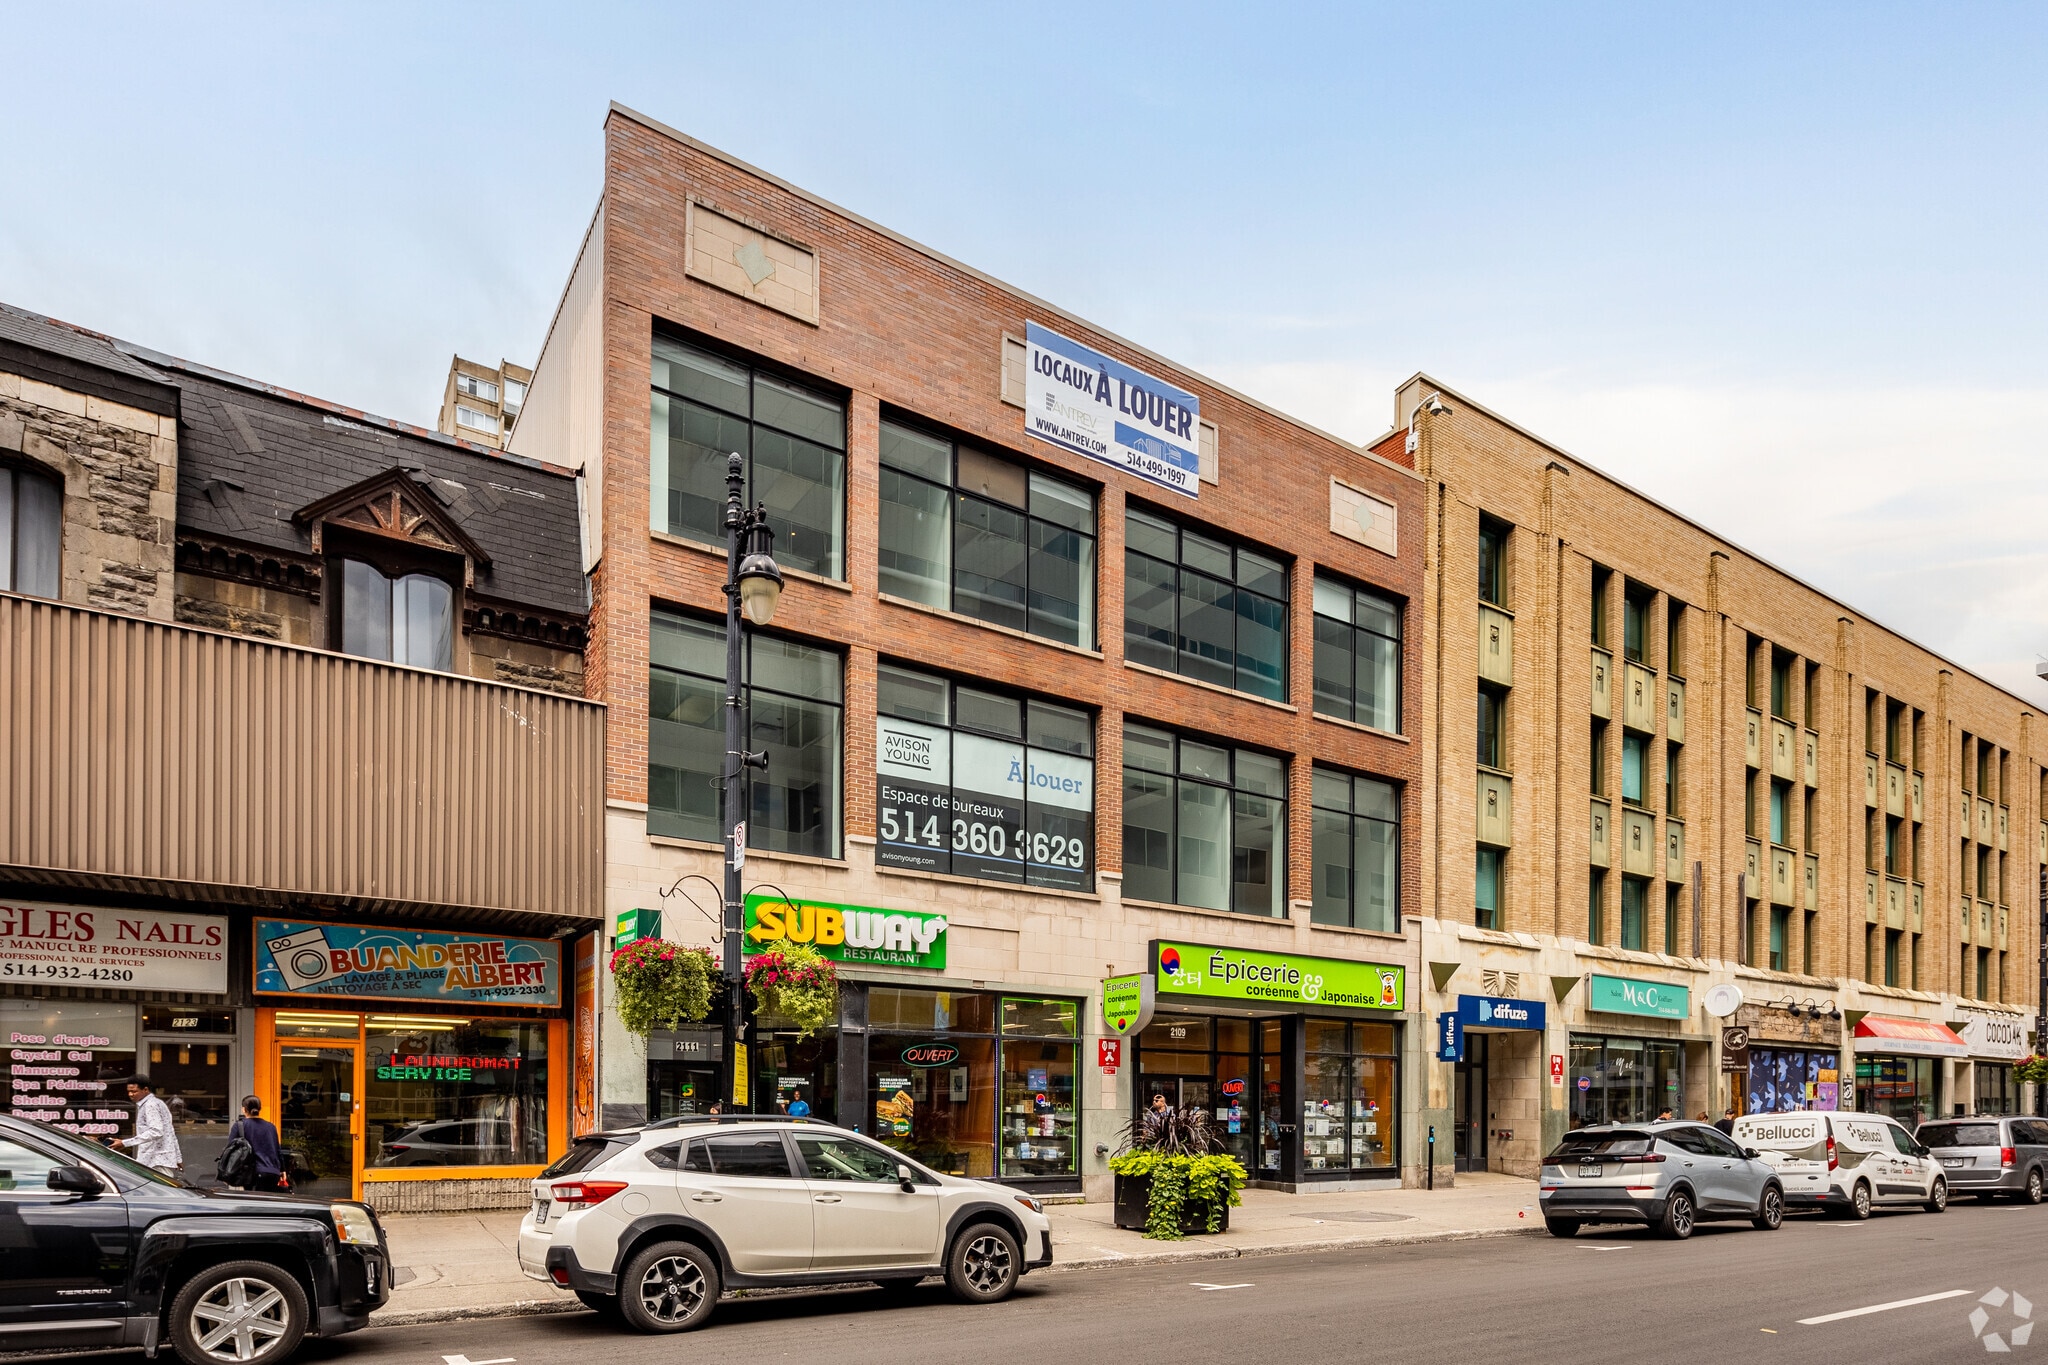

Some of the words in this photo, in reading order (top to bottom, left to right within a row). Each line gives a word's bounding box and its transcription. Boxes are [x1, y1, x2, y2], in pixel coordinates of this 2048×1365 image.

[1034, 350, 1093, 395] LOCAUX
[1094, 363, 1113, 408] À
[1119, 378, 1192, 442] LOUER
[1052, 401, 1098, 429] ANTREV
[1035, 416, 1107, 455] WWW.ANTREV.COM
[885, 735, 930, 753] AVISON
[885, 748, 930, 765] YOUNG
[1006, 755, 1024, 783] À
[1029, 765, 1083, 794] louer
[882, 785, 929, 806] Espace
[932, 793, 949, 809] de
[952, 796, 1004, 819] bureaux
[880, 807, 941, 847] 514
[952, 819, 1006, 857] 360
[1014, 829, 1084, 868] 3629
[881, 852, 936, 865] avisonyoung.com
[116, 919, 222, 947] NAILS
[745, 901, 949, 954] SUBWAY
[71, 956, 96, 964] NAIL
[99, 957, 145, 967] SERVICES
[103, 946, 222, 962] PROFESSIONNELS
[329, 940, 507, 974] BUANDERIE
[843, 948, 922, 965] RESTAURANT
[3, 963, 134, 982] 514-932-4280
[1209, 950, 1300, 985] Épicerie
[344, 972, 391, 984] LAVAGE
[394, 973, 403, 982] &
[406, 970, 446, 980] PLIAGE
[444, 960, 547, 992] ALBERT
[317, 983, 388, 995] NETTOYAGE
[402, 980, 423, 990] SEC
[469, 985, 547, 999] 514-932-2330
[1246, 984, 1300, 999] coréenne
[1301, 973, 1324, 1001] &
[1321, 990, 1375, 1005] Japonaise
[1107, 993, 1138, 1003] coréenne
[1107, 1009, 1138, 1019] Japonaise
[1493, 1003, 1528, 1021] difuze
[173, 1018, 198, 1027] 2123
[1170, 1027, 1186, 1037] 2109
[1445, 1016, 1455, 1046] difuze
[11, 1032, 46, 1043] Pose
[53, 1034, 110, 1047] d'ongles
[676, 1041, 699, 1052] 2111
[11, 1050, 61, 1062] Crystal
[68, 1051, 92, 1061] Gel
[390, 1053, 523, 1070] LAUNDROMAT
[907, 1048, 955, 1062] OUVERT
[11, 1064, 80, 1075] Manucure
[377, 1066, 472, 1081] SERVICE
[12, 1079, 41, 1091] Spa
[46, 1078, 107, 1090] Pédicure
[12, 1095, 67, 1105] Shellac
[12, 1109, 60, 1121] Design
[79, 1109, 93, 1119] la
[96, 1109, 129, 1119] Main
[1756, 1123, 1816, 1140] Bellucci
[1857, 1128, 1883, 1143] Bellucci
[56, 1288, 113, 1296] TERRAIN
